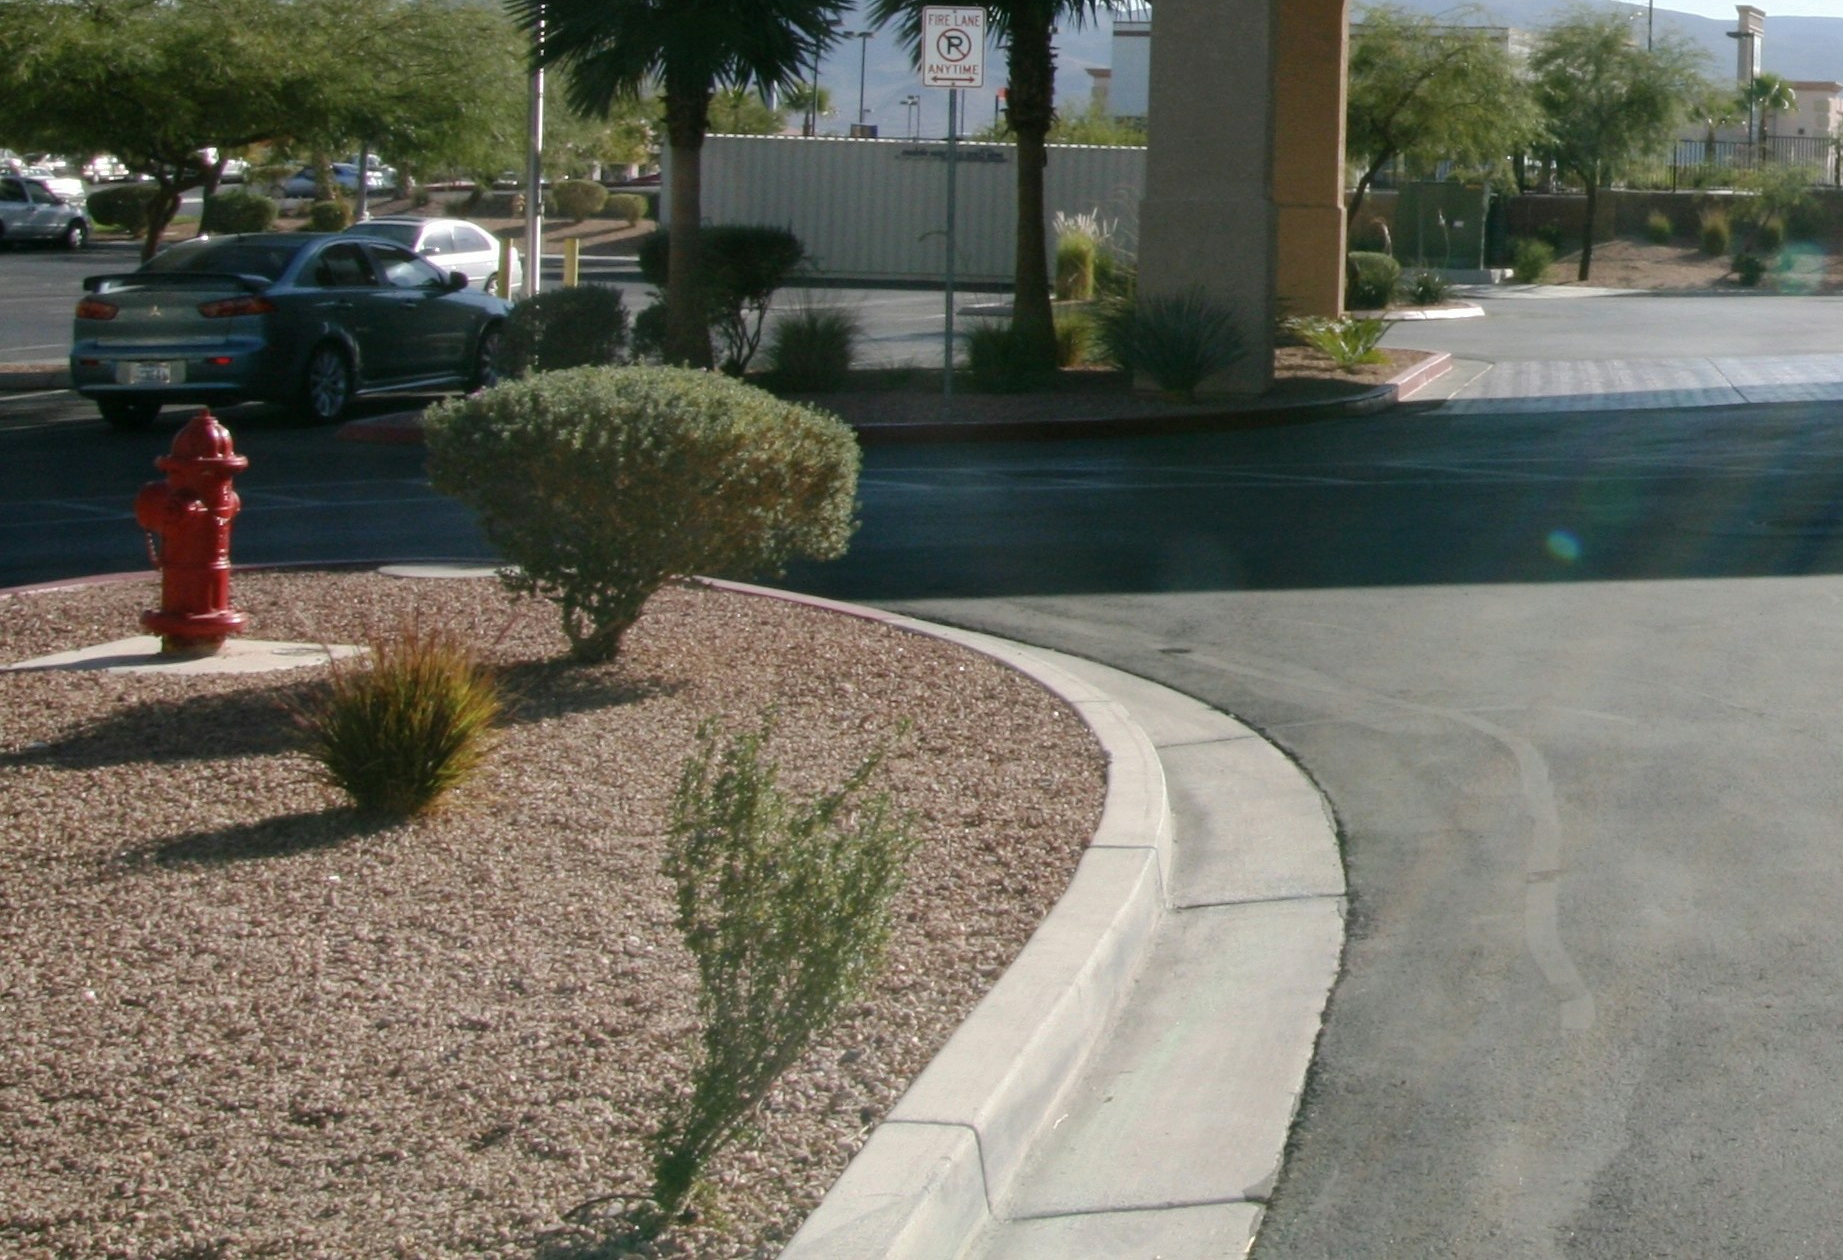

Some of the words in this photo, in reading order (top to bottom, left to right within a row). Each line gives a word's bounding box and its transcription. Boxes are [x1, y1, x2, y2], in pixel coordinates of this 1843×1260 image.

[928, 14, 950, 27] FIRE
[954, 14, 981, 28] LANE
[928, 64, 979, 75] ANYTIME
